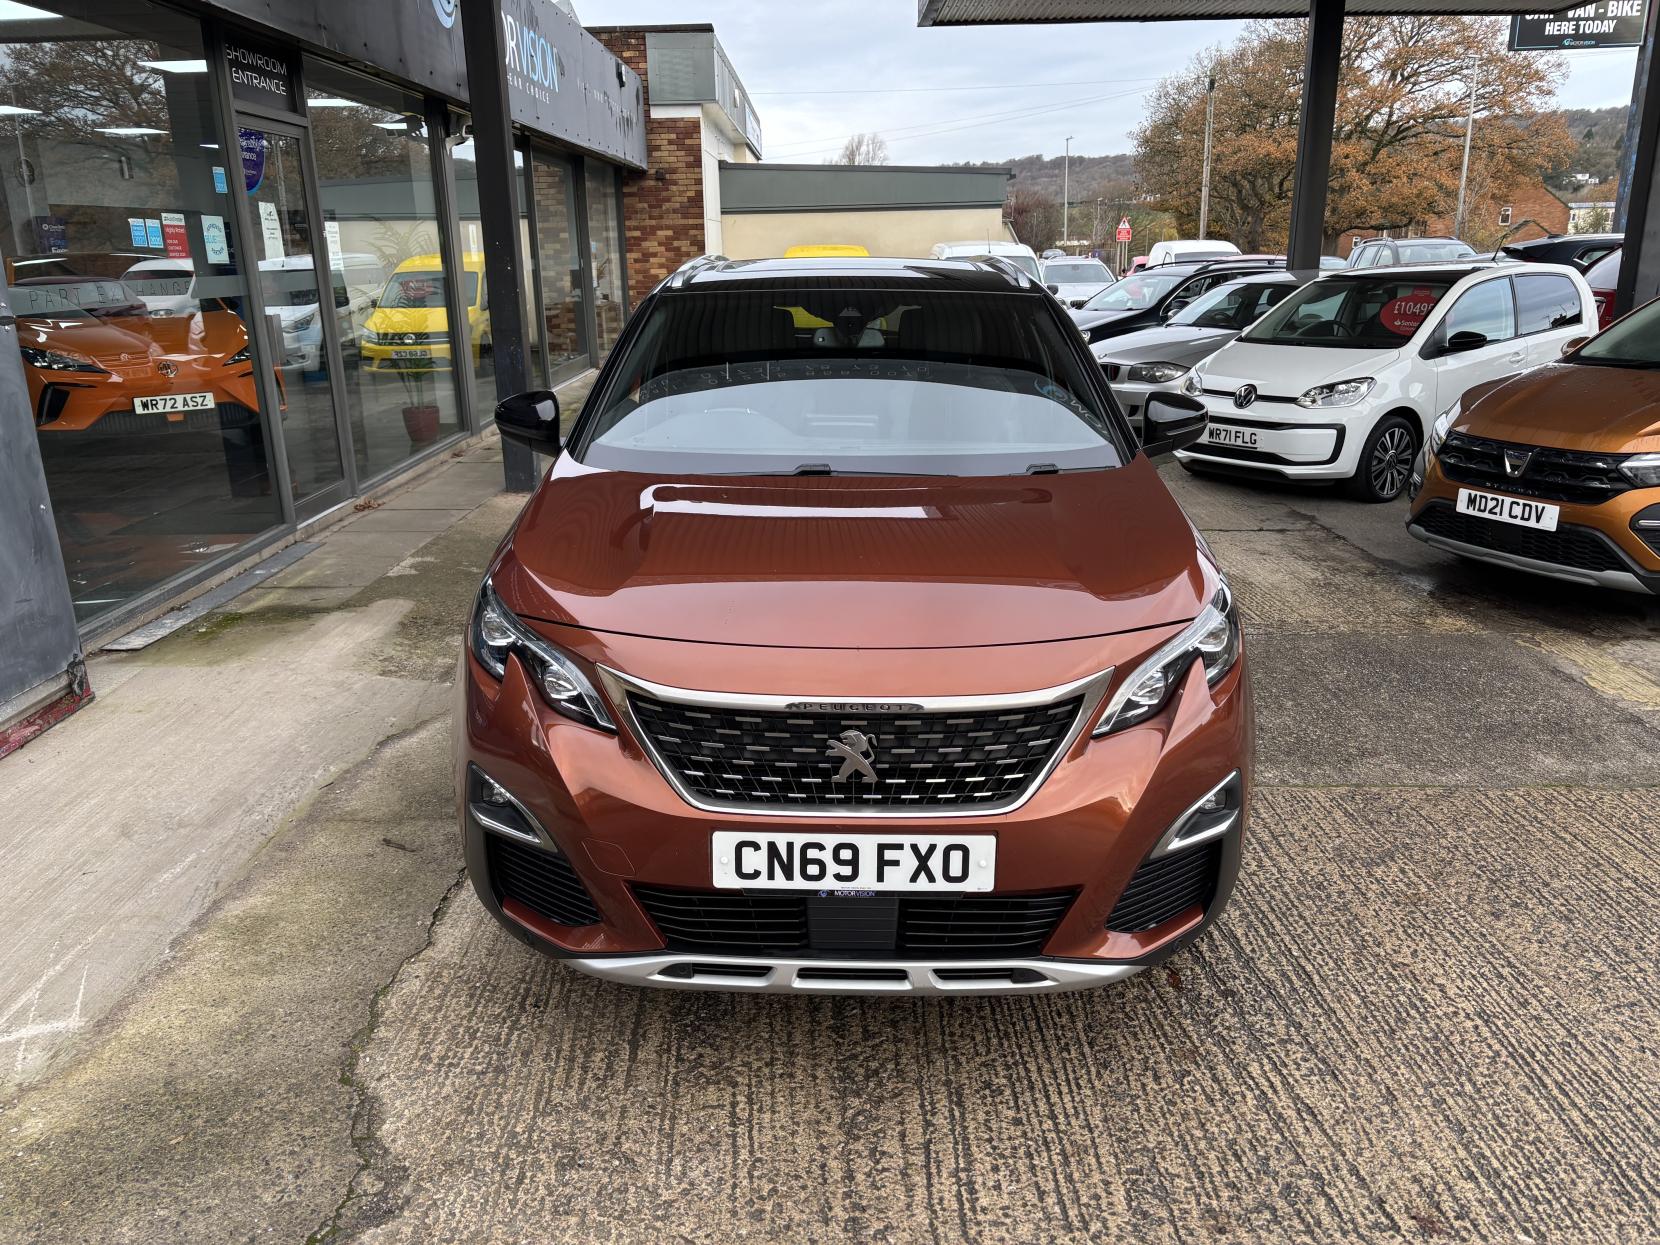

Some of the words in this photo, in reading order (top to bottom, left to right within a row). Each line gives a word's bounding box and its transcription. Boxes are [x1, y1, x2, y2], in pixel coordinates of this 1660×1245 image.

[1607, 0, 1642, 17] BIKE
[1545, 21, 1576, 35] HERE
[1578, 19, 1617, 34] TODAY
[226, 46, 288, 76] SHOWROOM
[232, 68, 287, 95] ENTRANCE
[28, 287, 82, 310] PART
[140, 397, 178, 412] WR72
[182, 395, 208, 408] ASZ
[1208, 426, 1232, 442] WR71
[1234, 430, 1257, 445] FLG
[1466, 492, 1505, 517] MD21
[1508, 500, 1546, 524] CDV
[803, 703, 906, 711] PEUGEOT
[734, 840, 860, 882] CN69
[876, 842, 970, 885] FXO
